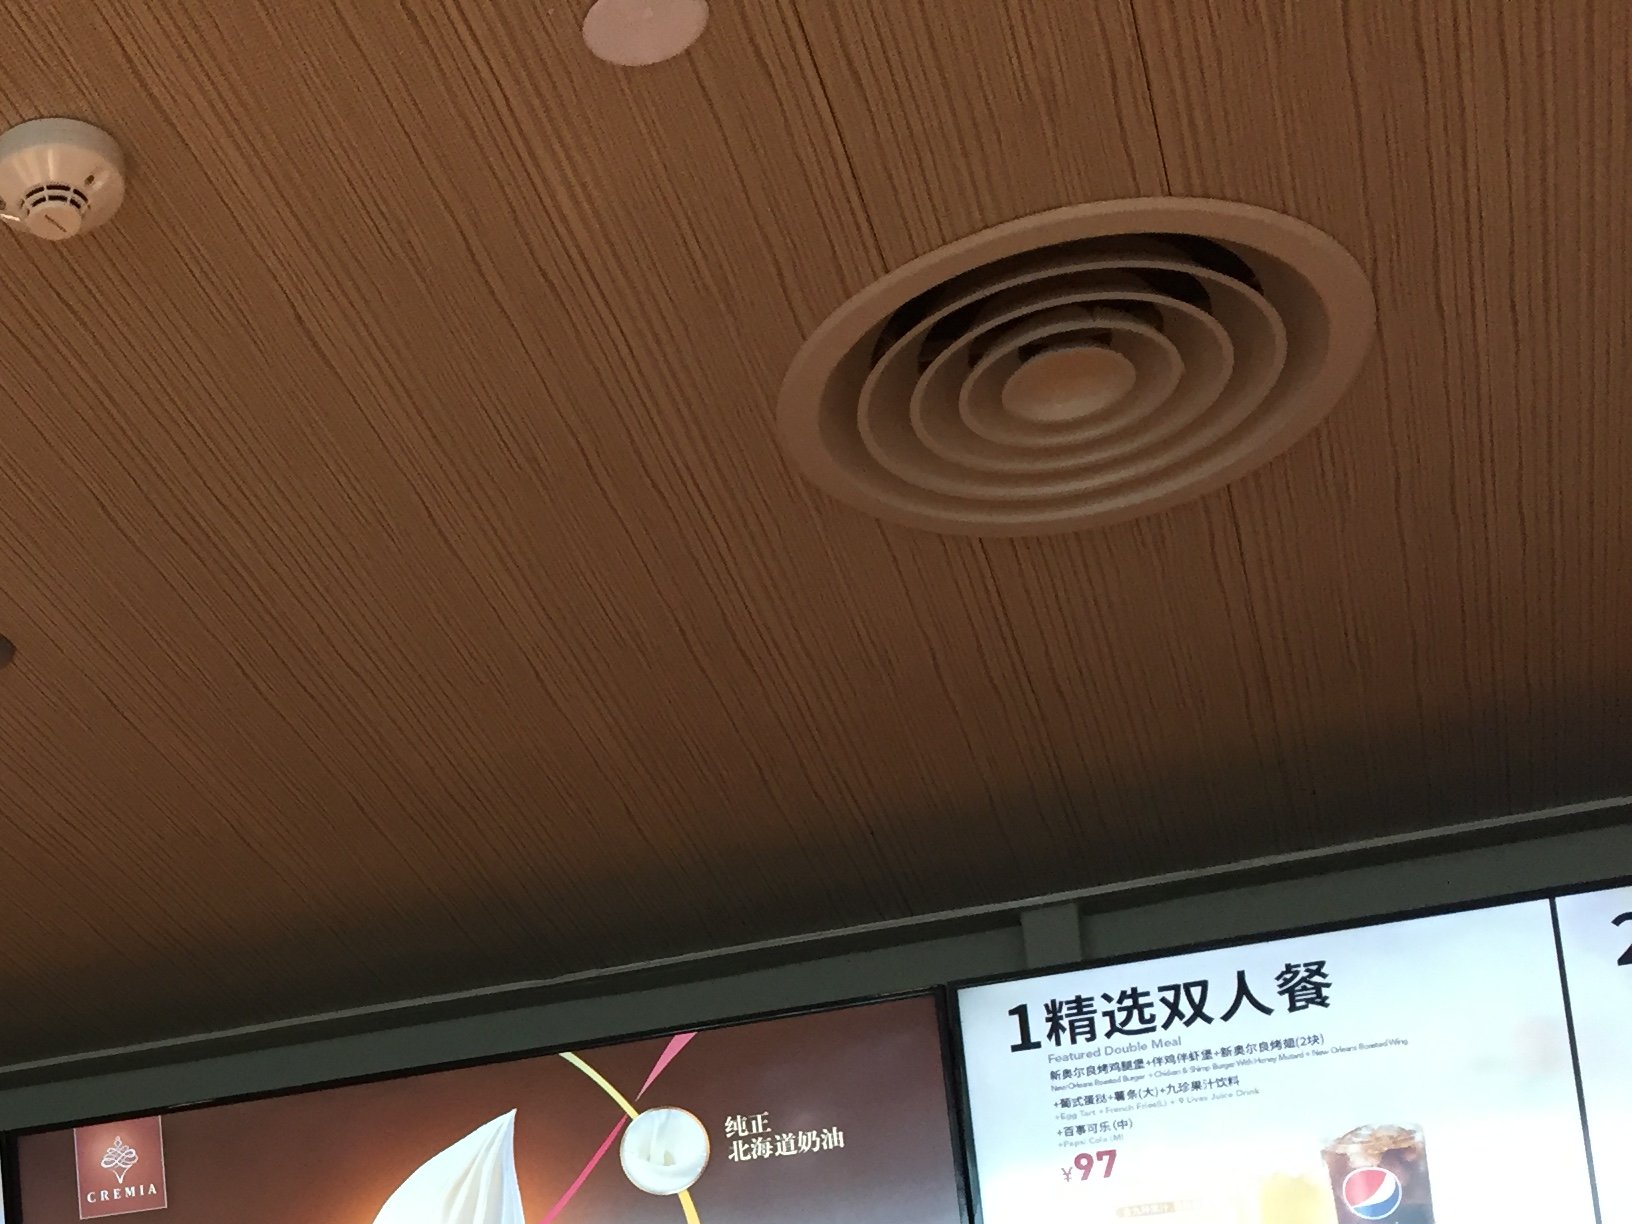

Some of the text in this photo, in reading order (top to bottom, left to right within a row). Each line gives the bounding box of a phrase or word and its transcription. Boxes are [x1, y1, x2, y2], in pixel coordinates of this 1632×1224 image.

[1048, 1036, 1182, 1064] Featured Double Meal
[724, 1111, 772, 1138] 纯正
[728, 1126, 845, 1162] 北海道奶油
[1061, 1149, 1117, 1182] ¥97
[87, 1183, 157, 1203] CREMIA
